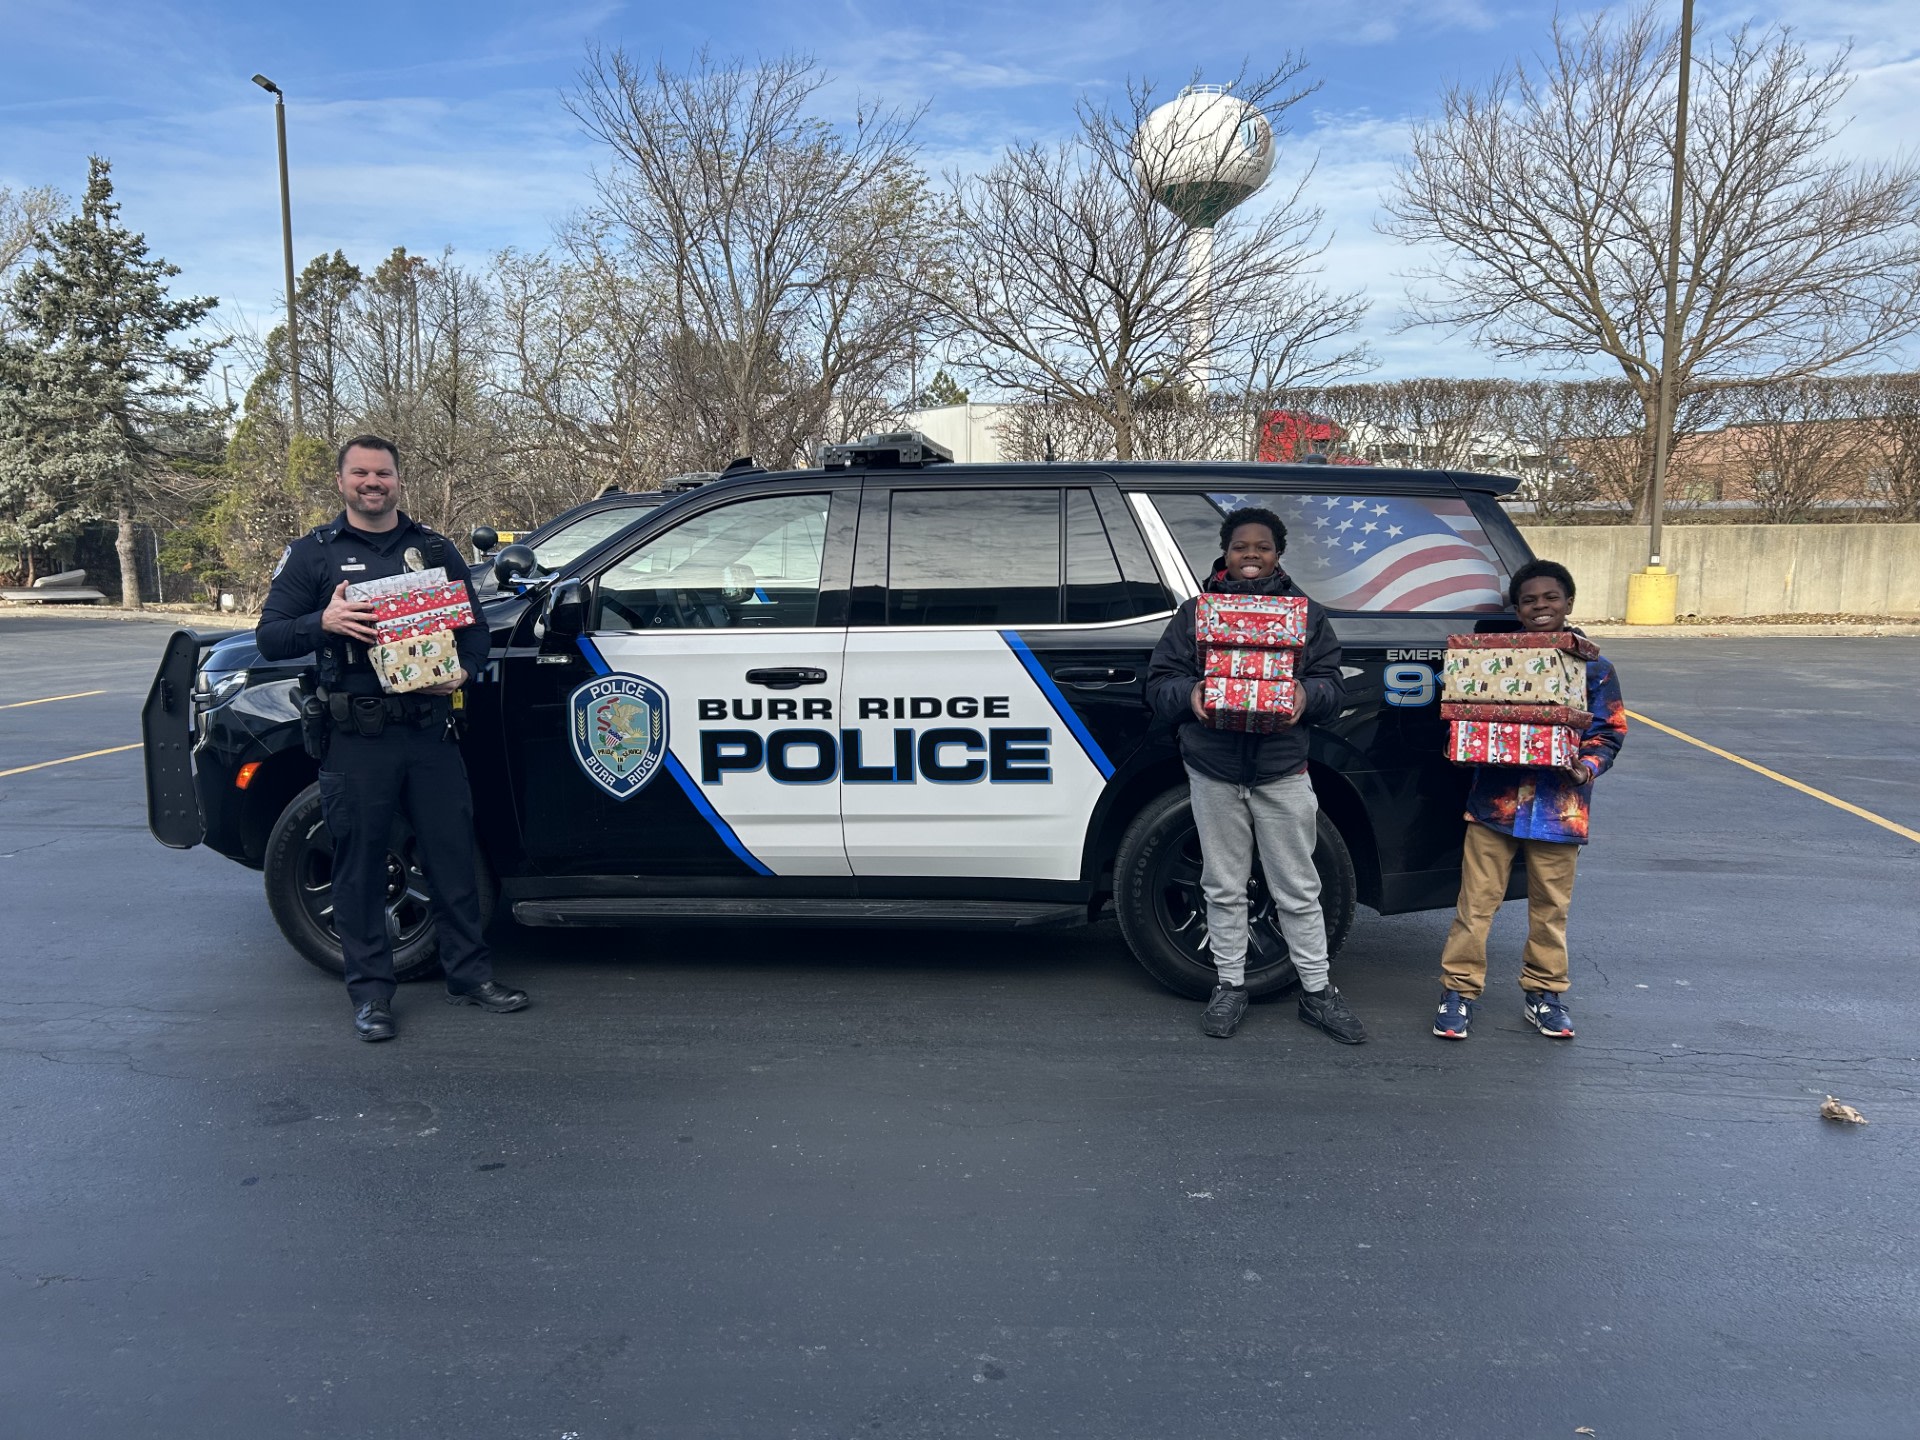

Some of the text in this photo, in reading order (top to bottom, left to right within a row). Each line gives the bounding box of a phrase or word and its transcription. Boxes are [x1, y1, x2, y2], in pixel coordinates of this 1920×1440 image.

[589, 681, 648, 699] POLICE
[697, 696, 1010, 721] BURR RIDGE
[585, 751, 658, 786] BURR RIDGE
[699, 727, 1053, 786] POLICE
